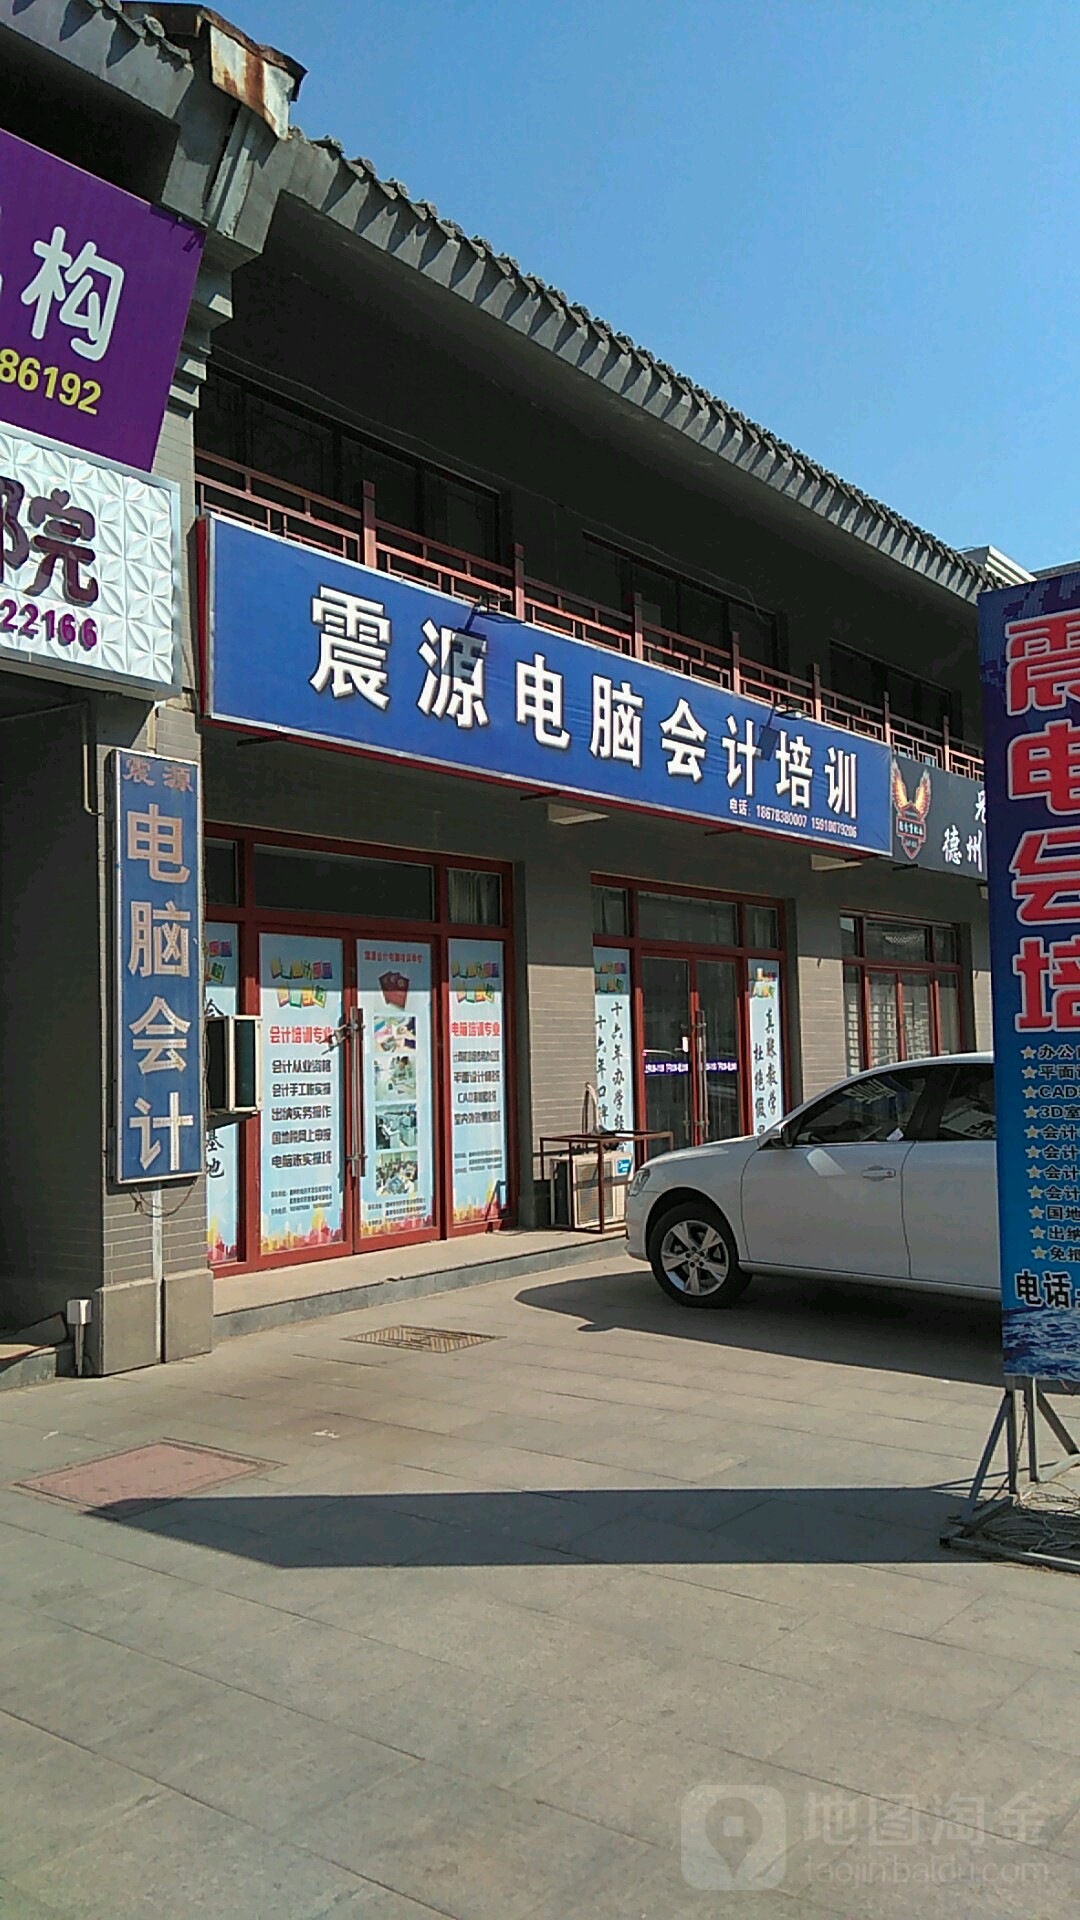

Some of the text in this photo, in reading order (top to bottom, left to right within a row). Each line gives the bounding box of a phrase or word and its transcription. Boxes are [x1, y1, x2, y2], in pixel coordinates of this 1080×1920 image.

[0, 348, 102, 415] 86192
[0, 599, 98, 651] 22166
[309, 585, 858, 820] 震源电脑会计培训
[942, 824, 983, 873] 德州
[126, 803, 195, 1172] 电脑会计
[451, 1021, 501, 1037] 电脑培训专业
[1038, 1044, 1080, 1060] 办公
[1039, 1064, 1080, 1080] 平面
[1042, 1144, 1080, 1161] 会计
[1043, 1164, 1080, 1181] 会计
[1044, 1185, 1080, 1202] 会计
